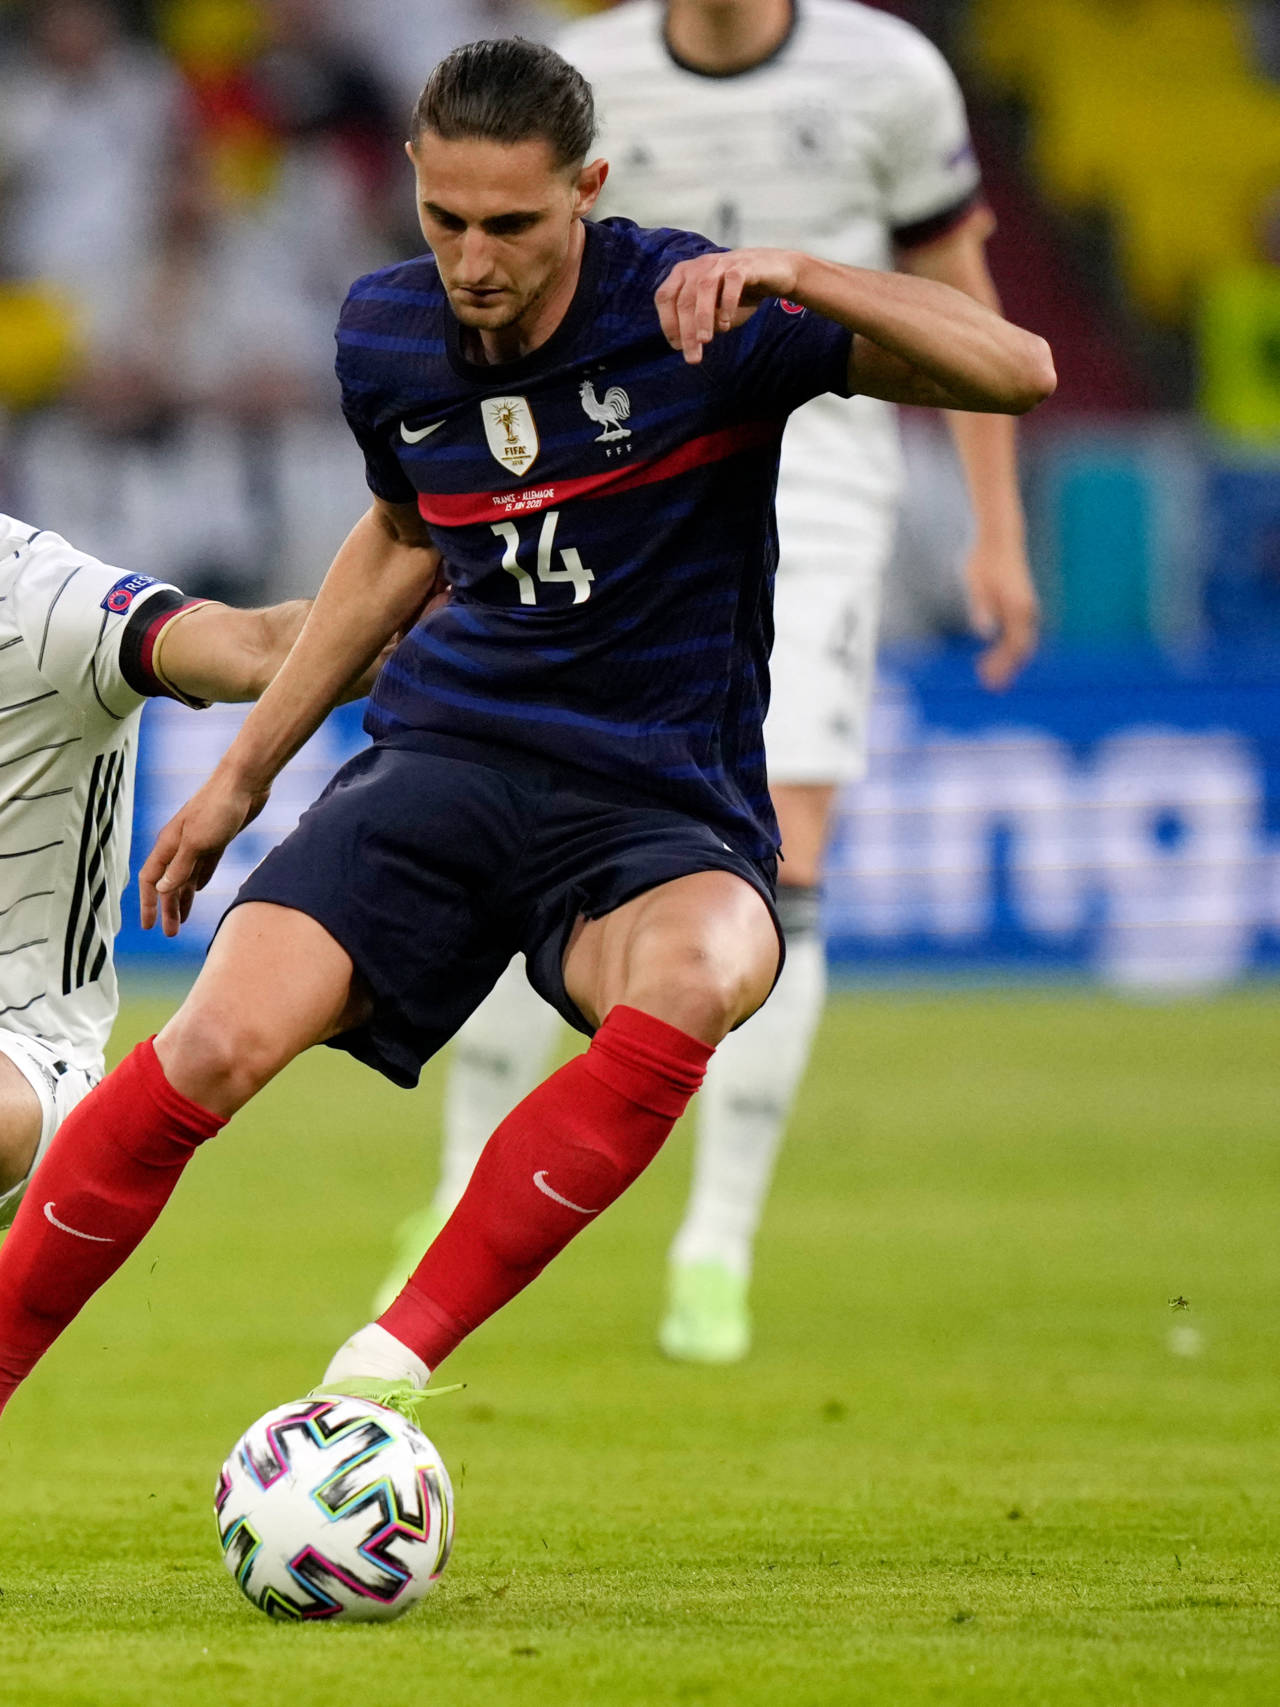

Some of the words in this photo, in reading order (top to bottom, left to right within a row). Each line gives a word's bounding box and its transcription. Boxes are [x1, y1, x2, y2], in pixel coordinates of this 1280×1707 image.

[504, 445, 525, 457] FIFA
[492, 493, 516, 505] FRANCE
[522, 488, 555, 501] ALLEMAGNE
[505, 503, 513, 512] 15
[526, 499, 543, 509] 2021
[490, 511, 595, 606] 14
